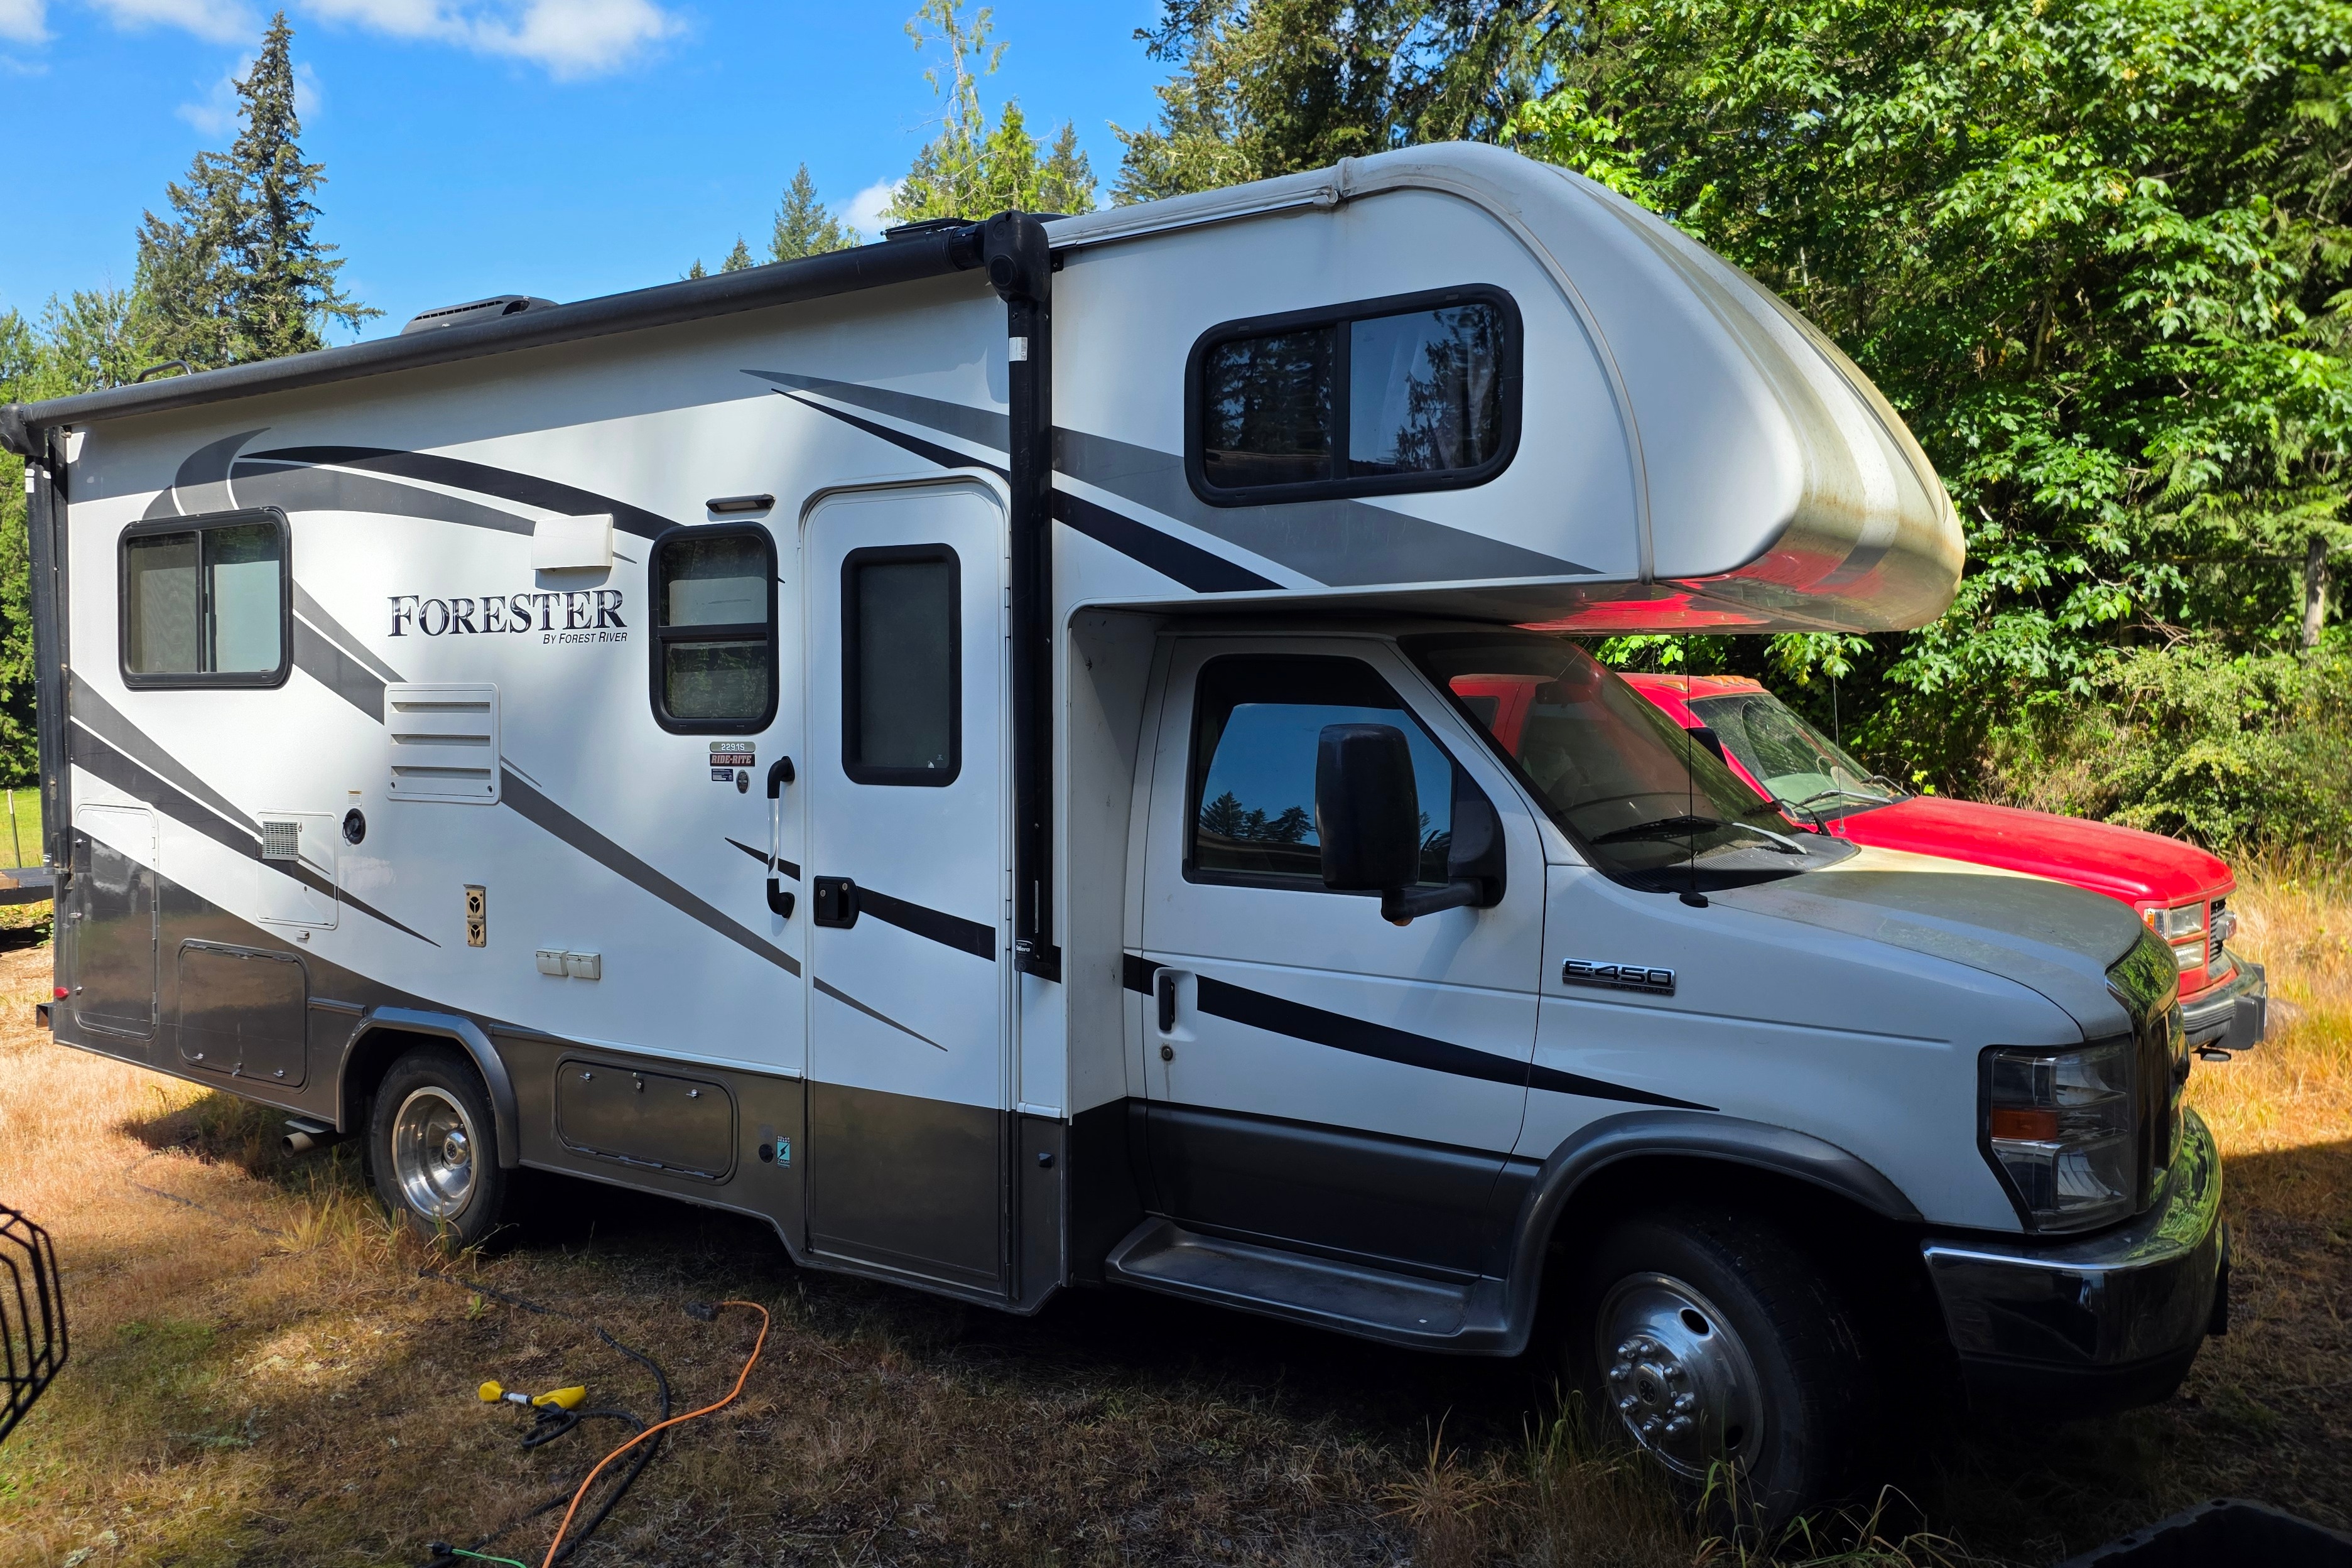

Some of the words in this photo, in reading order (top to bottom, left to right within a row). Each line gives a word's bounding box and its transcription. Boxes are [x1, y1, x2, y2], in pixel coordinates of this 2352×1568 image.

[387, 589, 627, 637] FORESTER
[559, 633, 596, 644] FOREST
[599, 631, 627, 642] RIVER
[721, 743, 745, 752] 2291S
[711, 755, 752, 764] RIDE-RITE
[1565, 960, 1672, 987] E-450
[1610, 983, 1642, 992] SUPER
